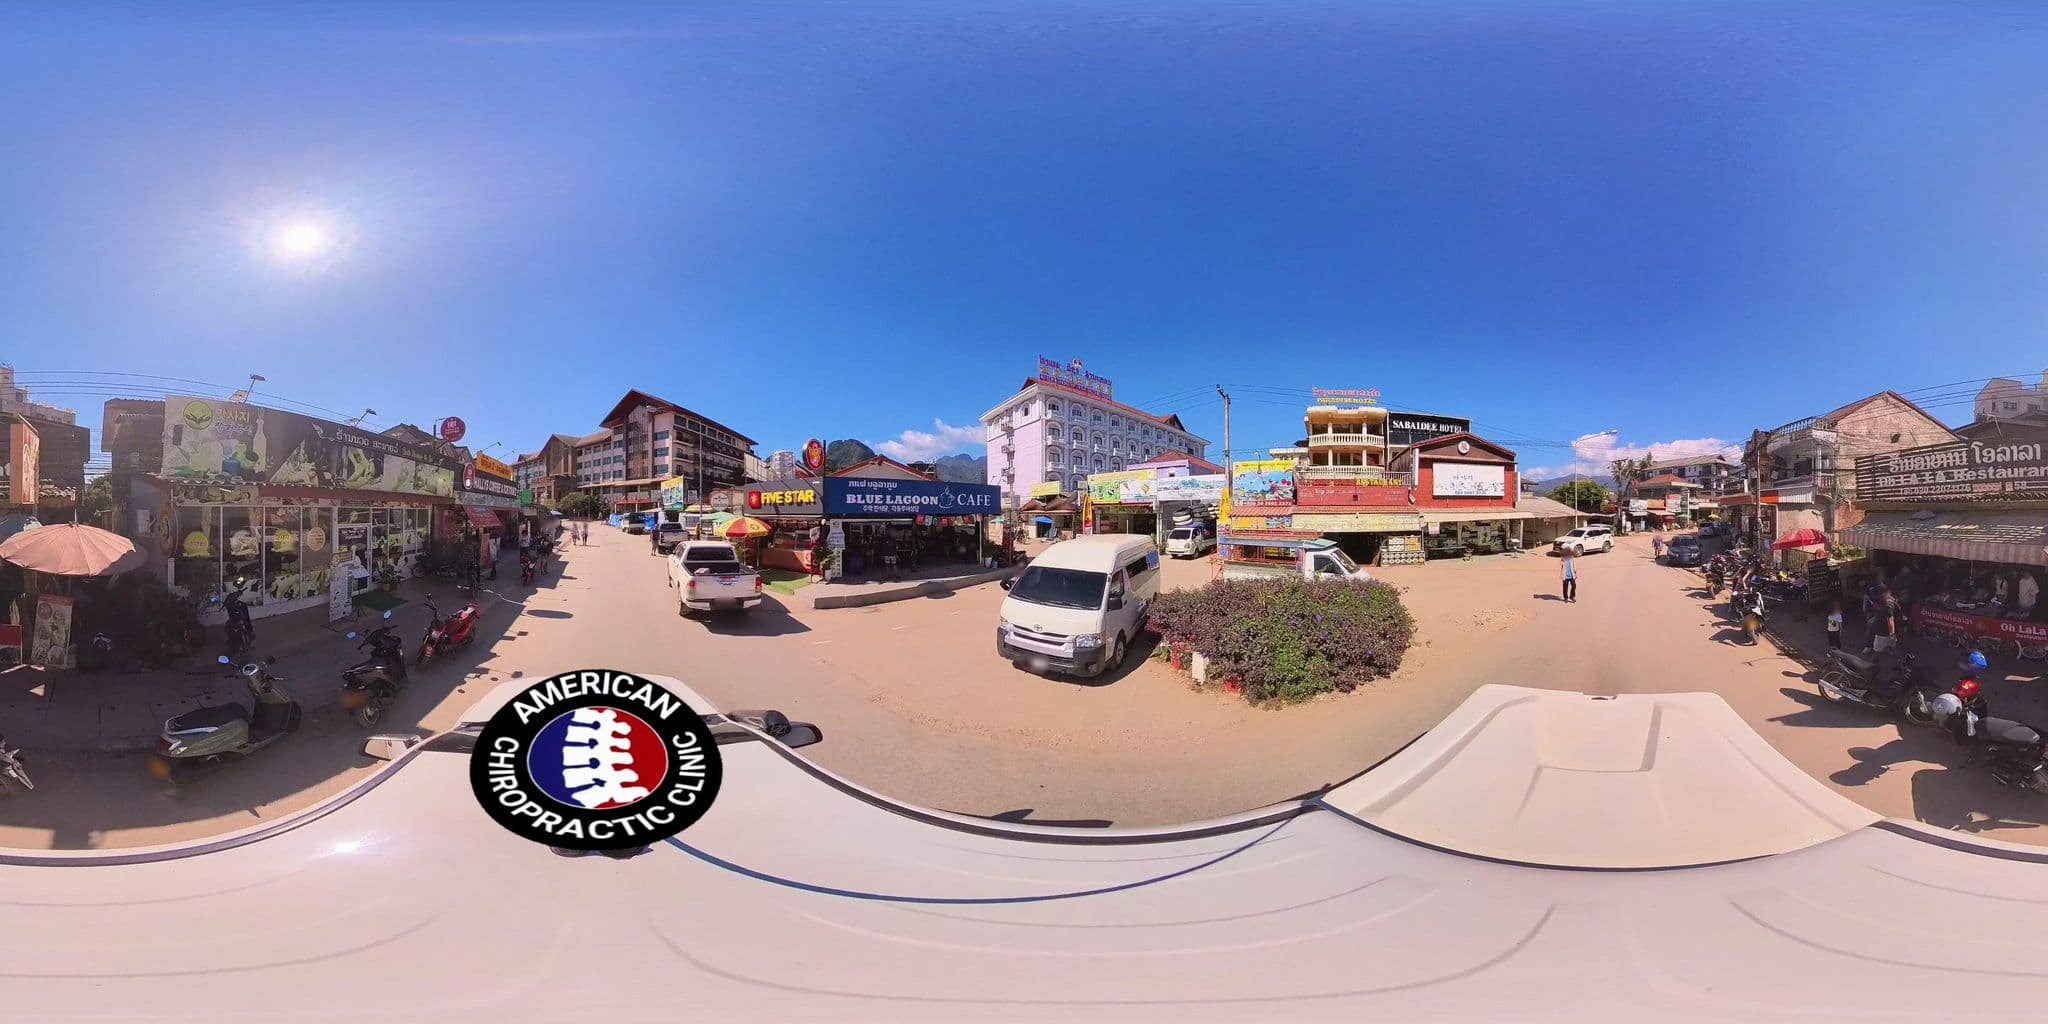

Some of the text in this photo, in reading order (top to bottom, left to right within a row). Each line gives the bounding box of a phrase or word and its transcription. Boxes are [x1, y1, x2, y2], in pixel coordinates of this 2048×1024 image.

[1393, 420, 1438, 432] SABAIDEE
[1439, 423, 1463, 433] HOTEL
[1971, 441, 2041, 464] ໂອລາລາ
[1356, 477, 1403, 487] RESTAURANT
[761, 489, 815, 504] FIVE STAR
[846, 493, 991, 507] BLUE LAGOON CAFE
[2000, 623, 2047, 636] Oh LaLa
